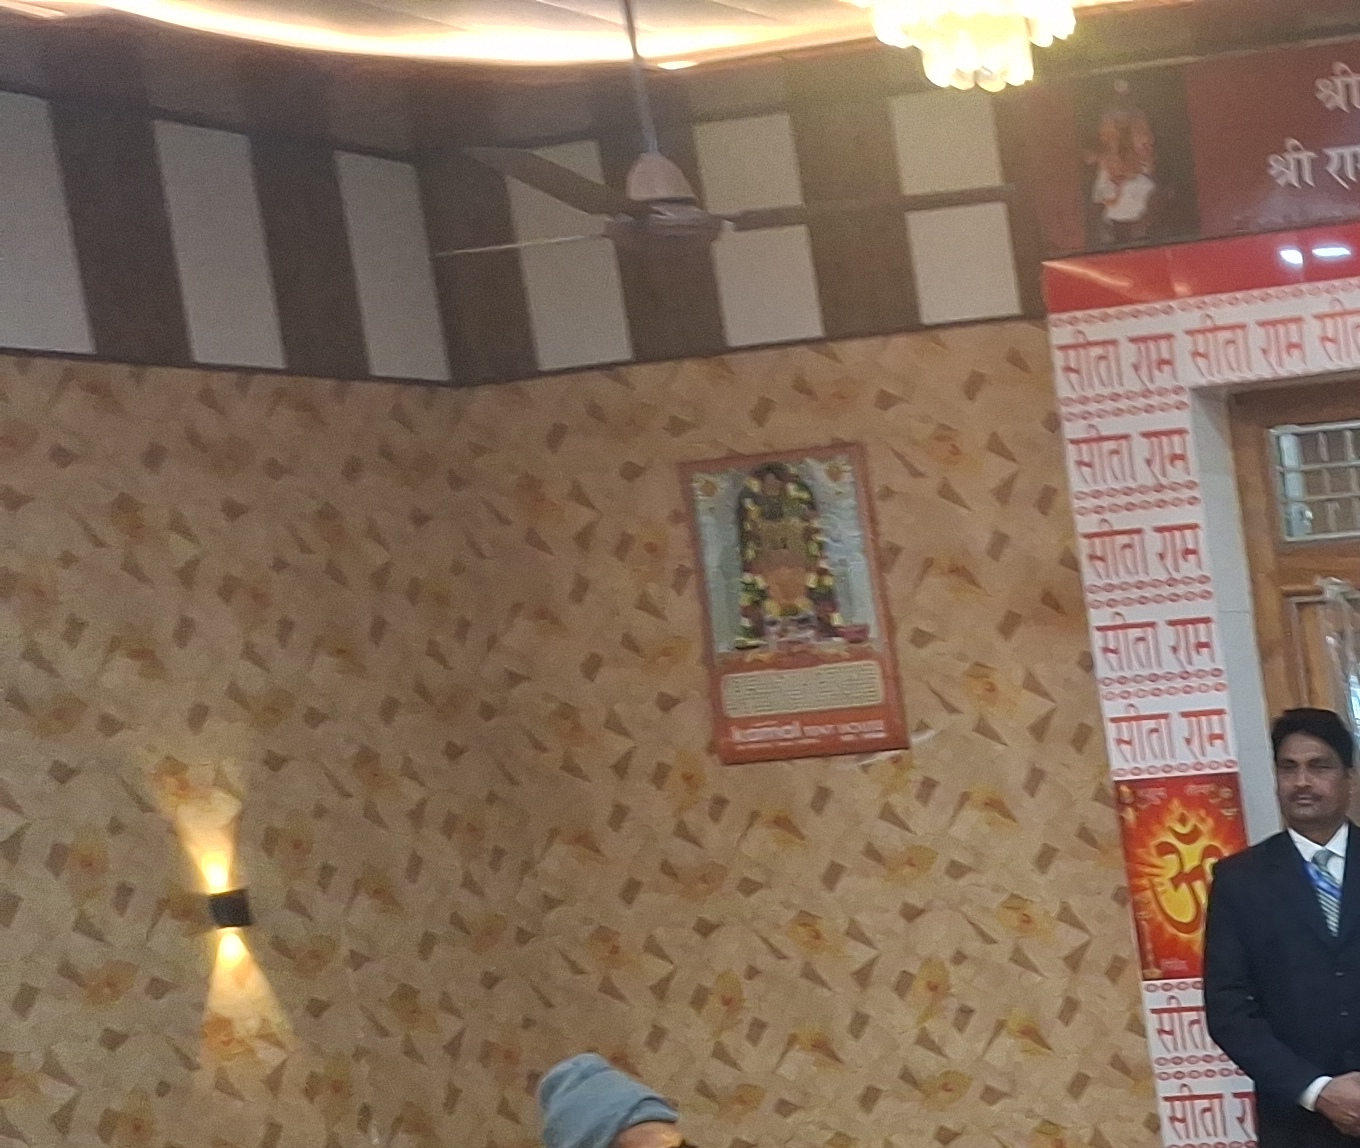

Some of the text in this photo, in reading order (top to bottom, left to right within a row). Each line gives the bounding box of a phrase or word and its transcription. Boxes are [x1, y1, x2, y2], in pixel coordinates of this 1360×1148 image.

[1267, 137, 1318, 188] श्री
[1057, 329, 1124, 393] सीता
[1128, 333, 1178, 387] राम
[1185, 313, 1252, 384] सीता
[1256, 315, 1308, 374] राम
[1067, 423, 1191, 485] सीता राम
[1079, 518, 1203, 580] सीता राम
[1095, 611, 1216, 673] सीता राम
[1108, 703, 1232, 763] सीता राम
[1162, 1083, 1227, 1140] सीता
